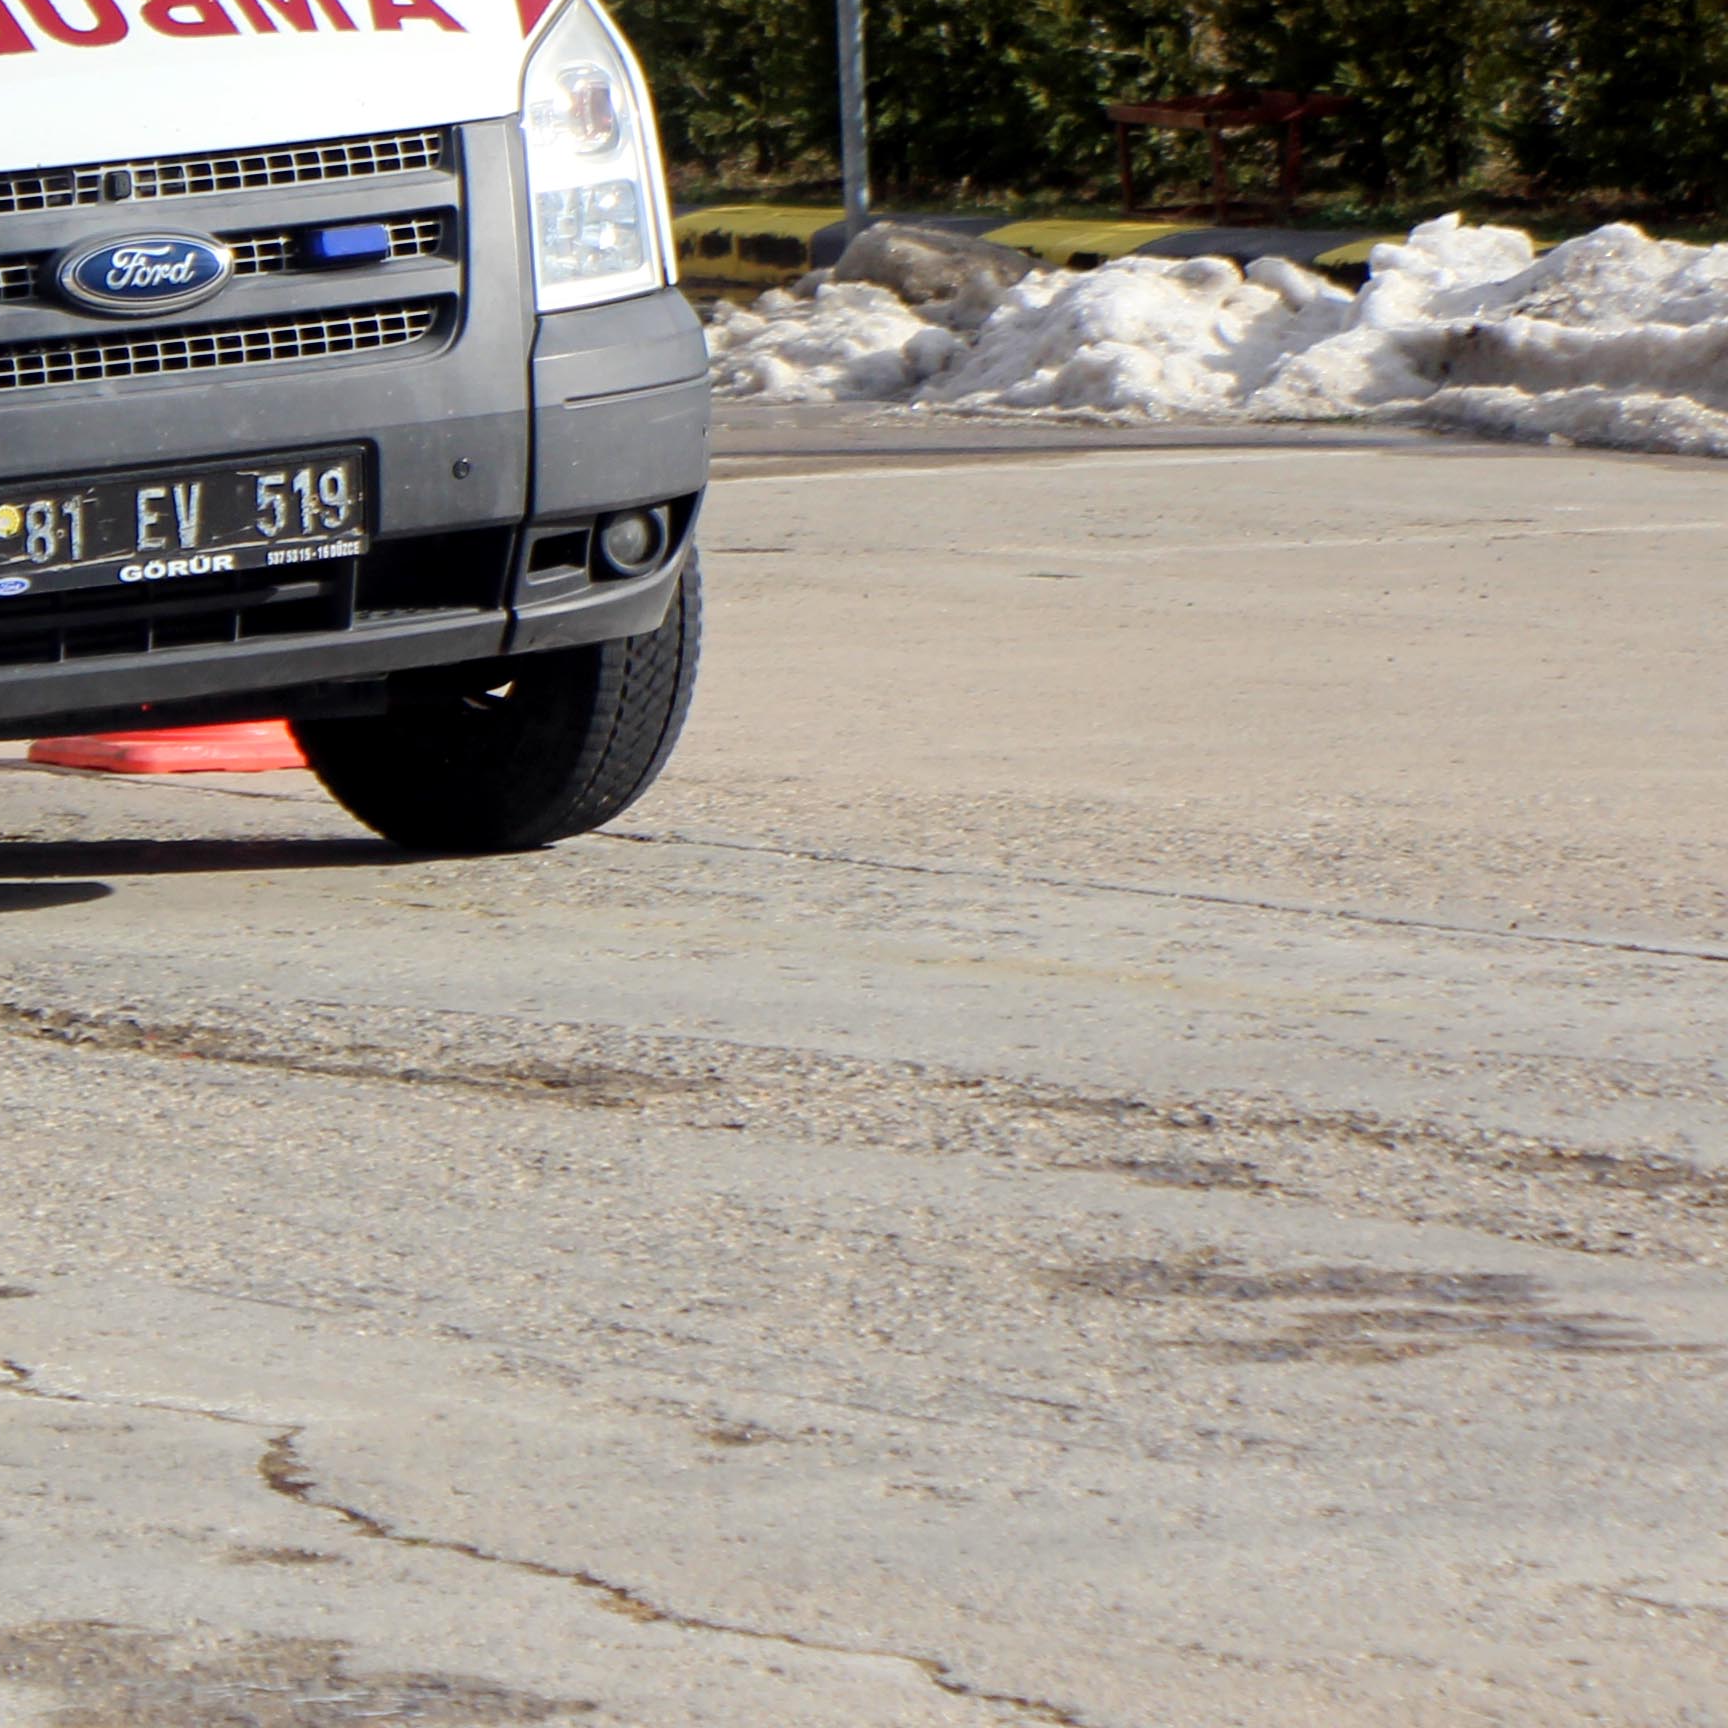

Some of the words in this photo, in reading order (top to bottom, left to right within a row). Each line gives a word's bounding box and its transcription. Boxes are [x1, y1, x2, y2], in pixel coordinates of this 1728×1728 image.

[106, 245, 196, 290] Ford
[24, 494, 84, 564] 81
[136, 482, 203, 552] EV
[256, 466, 350, 539] 519
[119, 552, 235, 585] GÖRÜR
